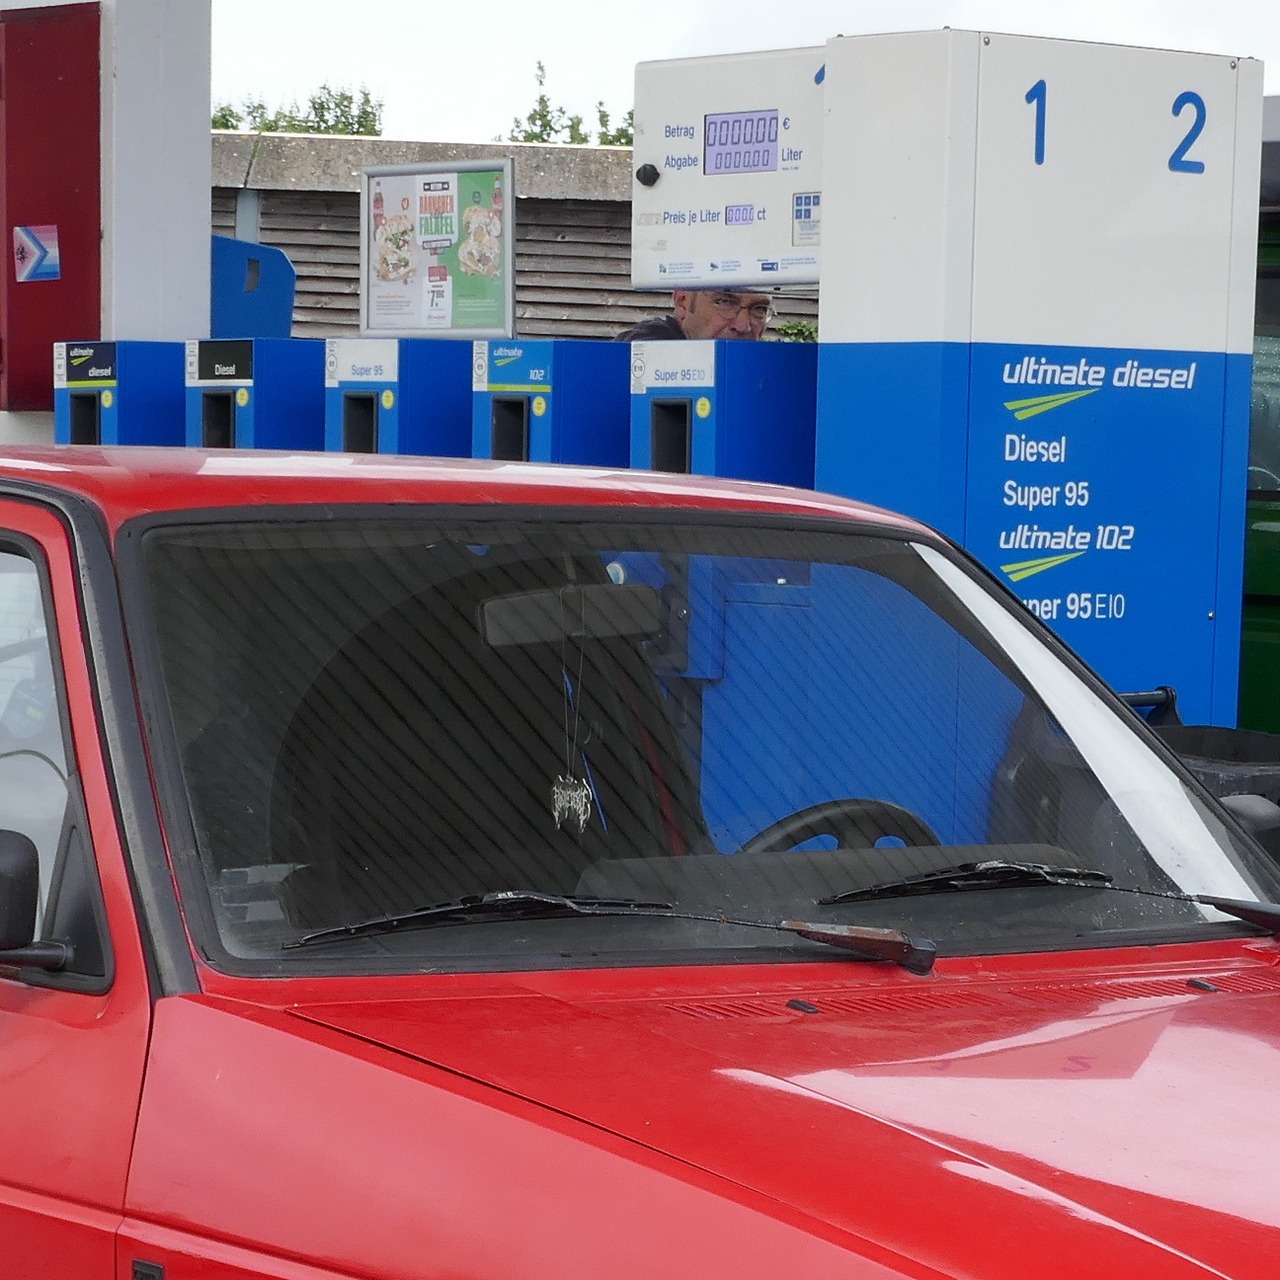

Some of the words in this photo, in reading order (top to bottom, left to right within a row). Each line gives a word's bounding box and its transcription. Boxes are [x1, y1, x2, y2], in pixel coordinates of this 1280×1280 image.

[1024, 79, 1047, 165] 1
[664, 125, 695, 139] Betrag
[1168, 91, 1208, 174] 2
[781, 148, 803, 161] Liter
[664, 155, 699, 170] Abgabe
[663, 210, 686, 224] Preis
[688, 210, 697, 226] je
[700, 209, 721, 223] Liter
[757, 207, 766, 221] ct
[493, 347, 523, 357] ultimate
[88, 366, 112, 377] diesel
[214, 364, 236, 376] Diesel
[351, 364, 372, 377] Super
[374, 365, 383, 376] 95
[529, 369, 544, 381] 102
[654, 369, 678, 382] Super
[1002, 356, 1106, 386] ultimate
[1112, 360, 1196, 390] diesel
[1004, 434, 1066, 463] Diesel
[1003, 479, 1060, 511] Super
[1064, 481, 1089, 507] 95
[999, 525, 1091, 550] ultimate
[1095, 525, 1135, 550] 102
[1022, 597, 1061, 620] per
